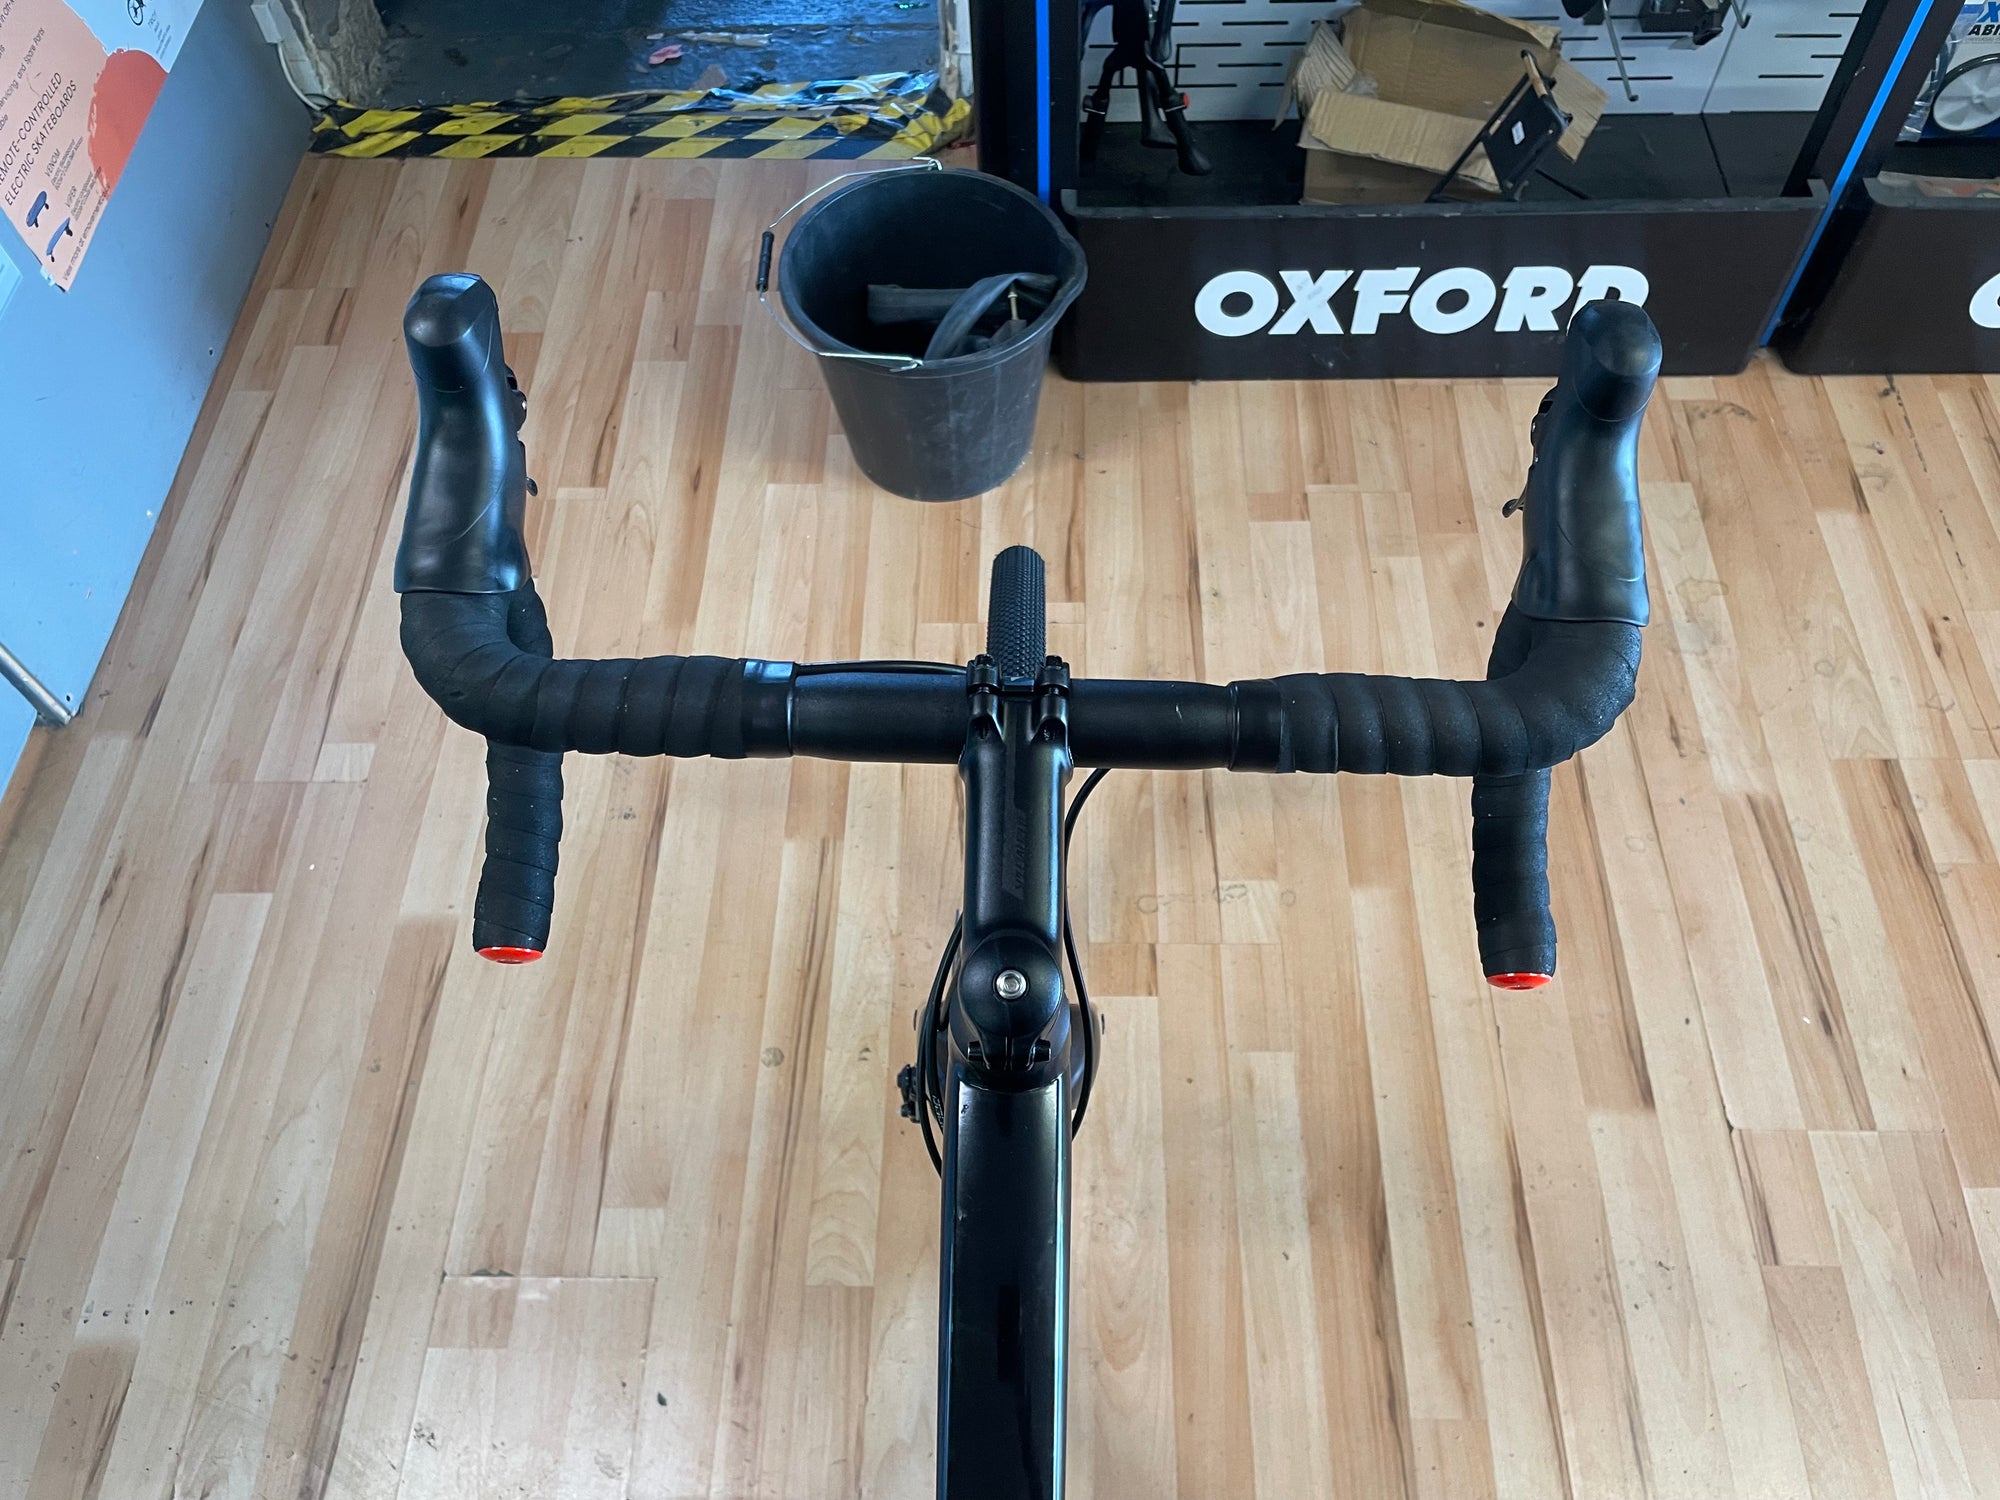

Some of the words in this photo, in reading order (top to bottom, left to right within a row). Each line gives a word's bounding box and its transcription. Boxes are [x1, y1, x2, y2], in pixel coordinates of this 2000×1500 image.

[0, 72, 62, 186] EMOTE-CONTROLLED
[4, 152, 35, 206] ELECTRIC
[31, 79, 77, 155] SKATEBOARDS
[45, 148, 60, 177] VENOM
[1195, 265, 1649, 336] OXFORD
